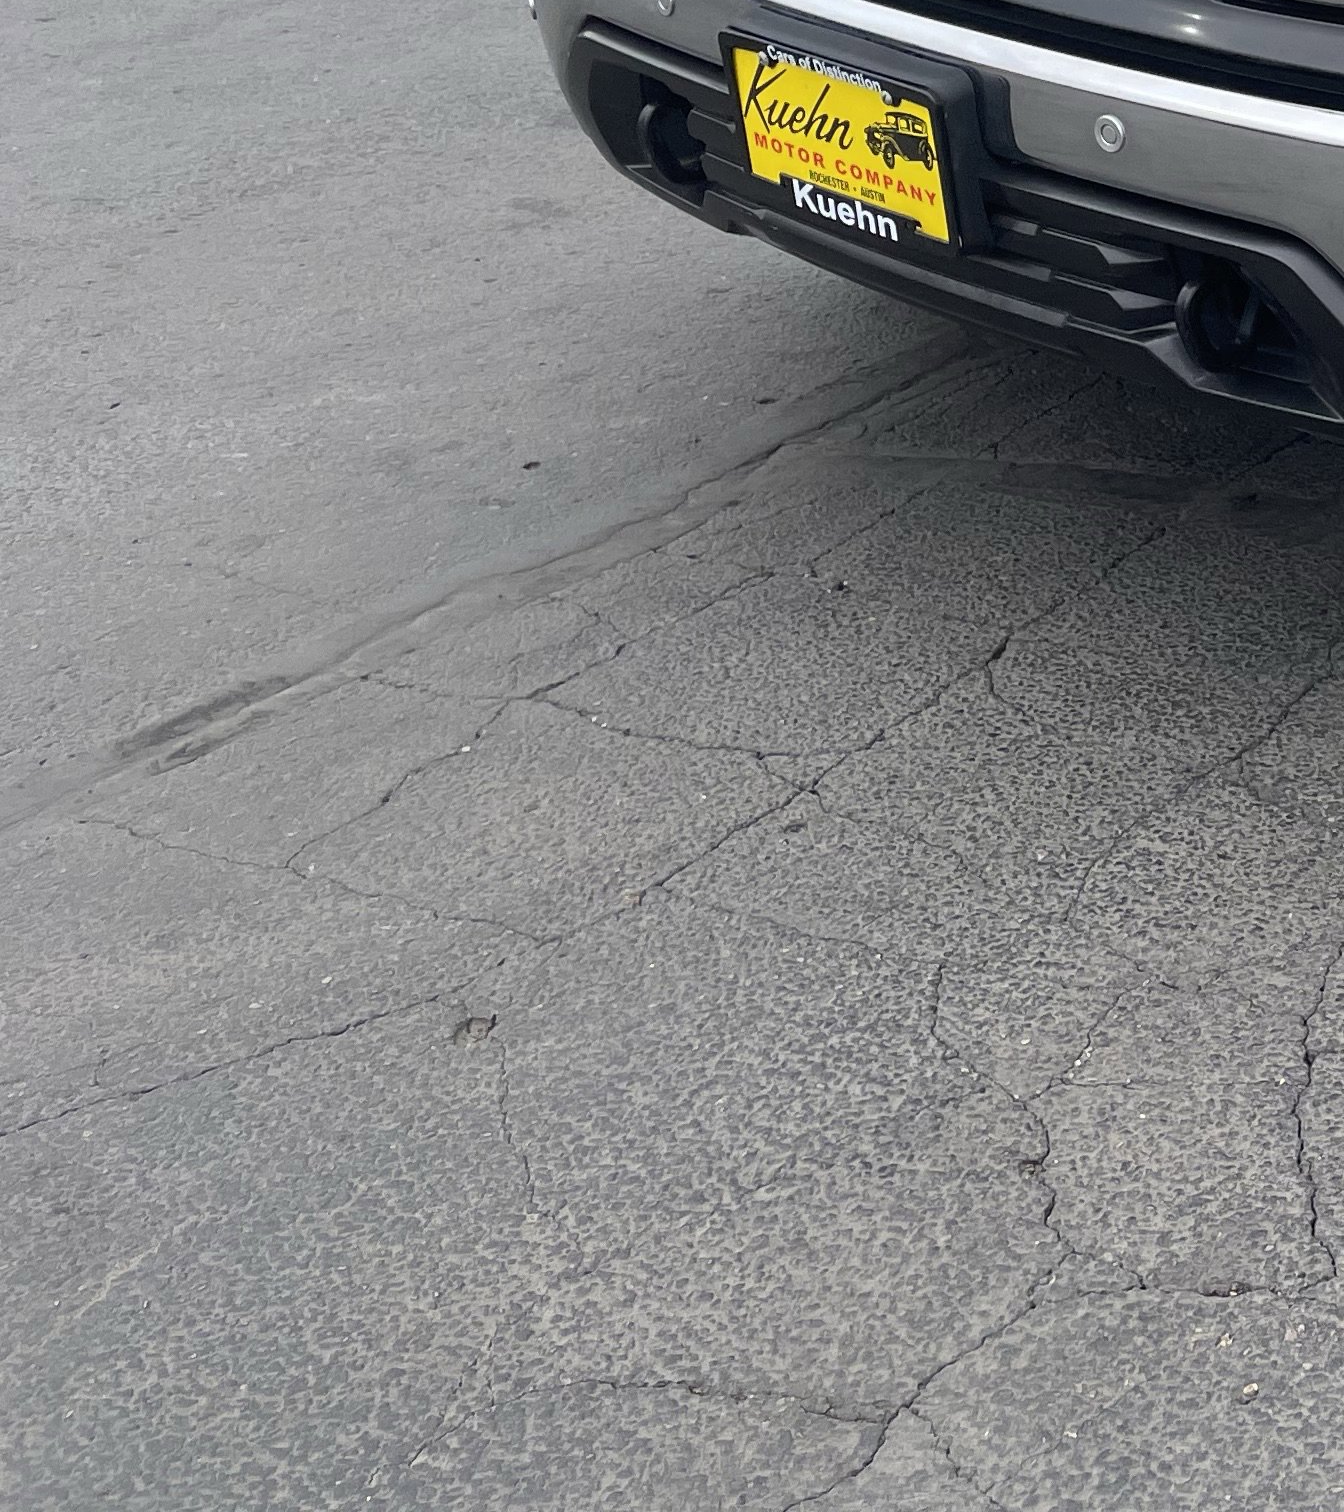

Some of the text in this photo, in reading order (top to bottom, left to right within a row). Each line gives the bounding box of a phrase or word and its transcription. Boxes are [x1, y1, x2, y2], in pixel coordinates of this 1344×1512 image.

[766, 44, 882, 93] Cars of Distinction
[743, 61, 853, 150] Kuehn
[754, 132, 936, 206] MOTOR COMPANY
[808, 169, 850, 192] ROCHESTER
[791, 178, 899, 243] Kuehn
